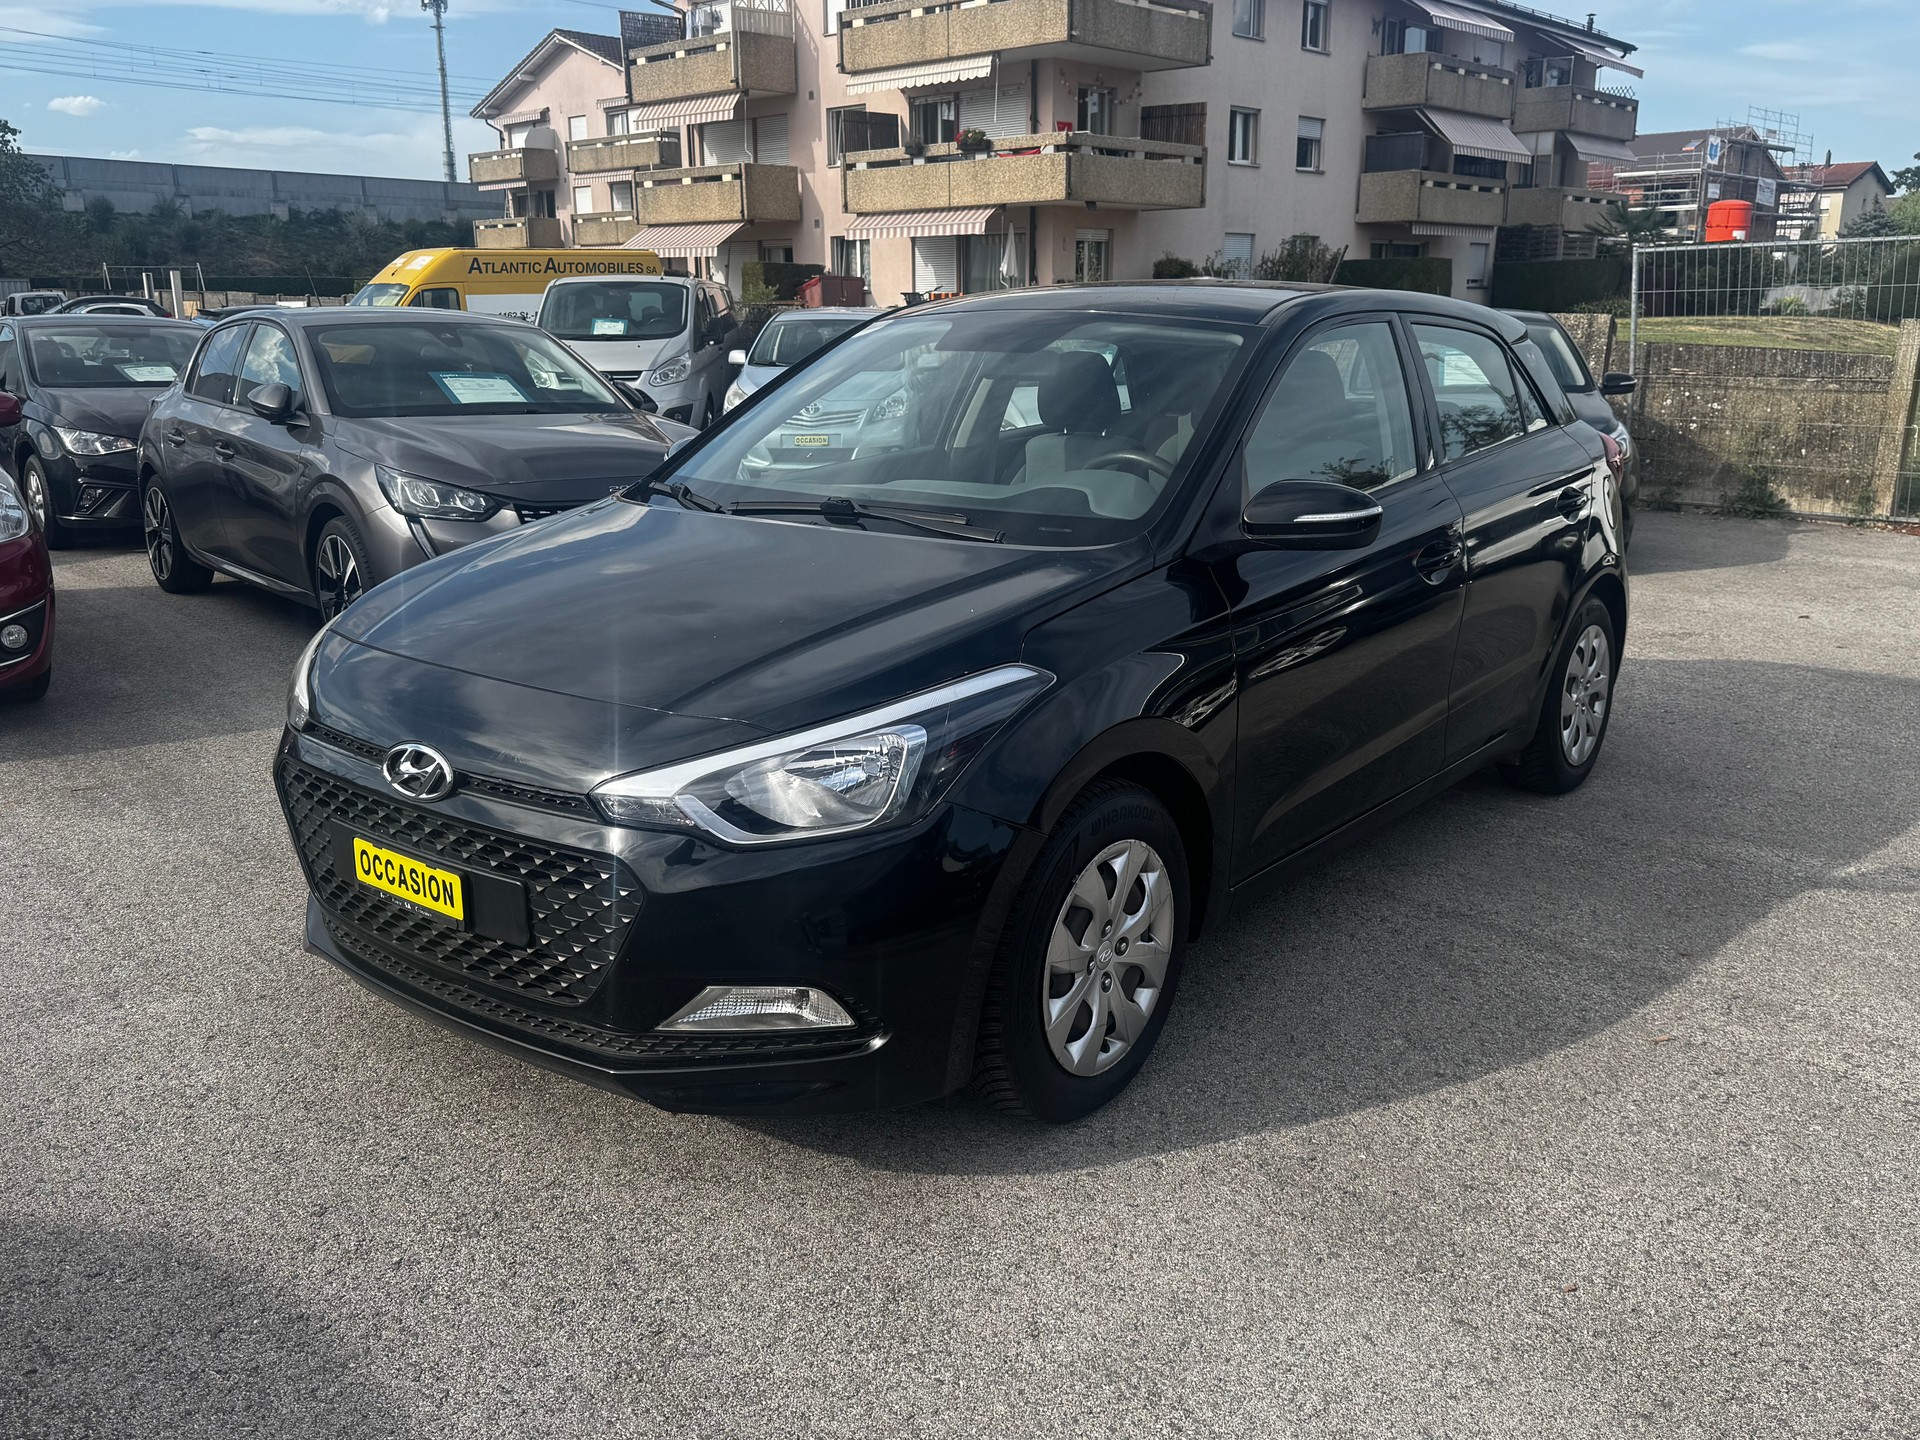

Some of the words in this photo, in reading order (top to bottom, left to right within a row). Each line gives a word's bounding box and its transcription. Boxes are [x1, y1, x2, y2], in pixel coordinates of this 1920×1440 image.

[468, 257, 541, 274] ATLANTIC
[544, 257, 644, 274] AUTOMOBILES
[646, 266, 657, 274] SA
[359, 848, 455, 909] OCCASION
